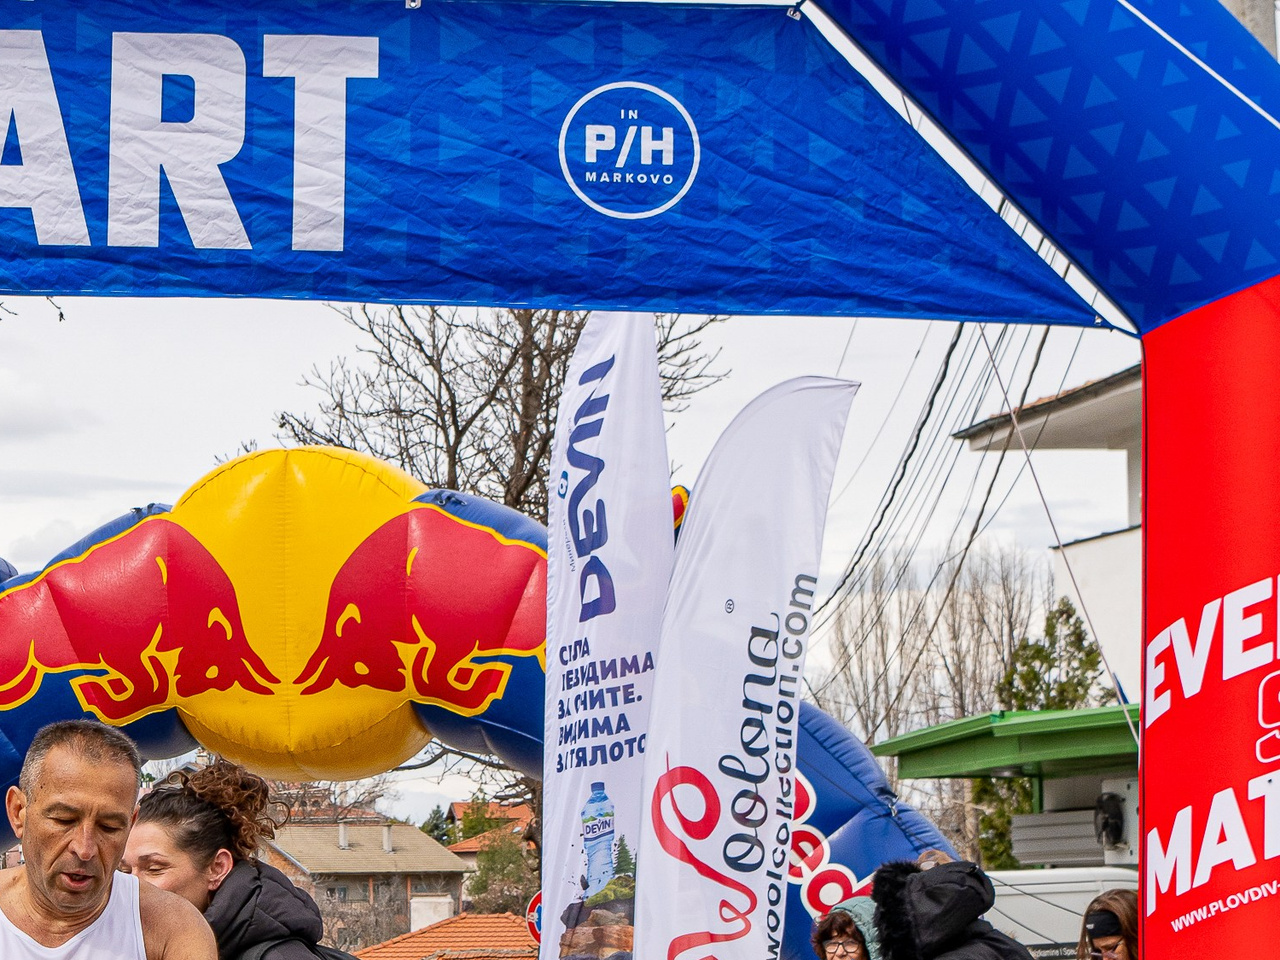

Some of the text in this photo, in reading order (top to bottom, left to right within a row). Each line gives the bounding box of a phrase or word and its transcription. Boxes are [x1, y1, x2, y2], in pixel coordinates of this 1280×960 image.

[619, 109, 638, 120] IN
[584, 124, 675, 169] P/H
[584, 171, 675, 186] MARKOVO
[566, 354, 617, 623] DEVIN
[1146, 574, 1280, 729] EVE
[585, 819, 612, 835] DEVIN
